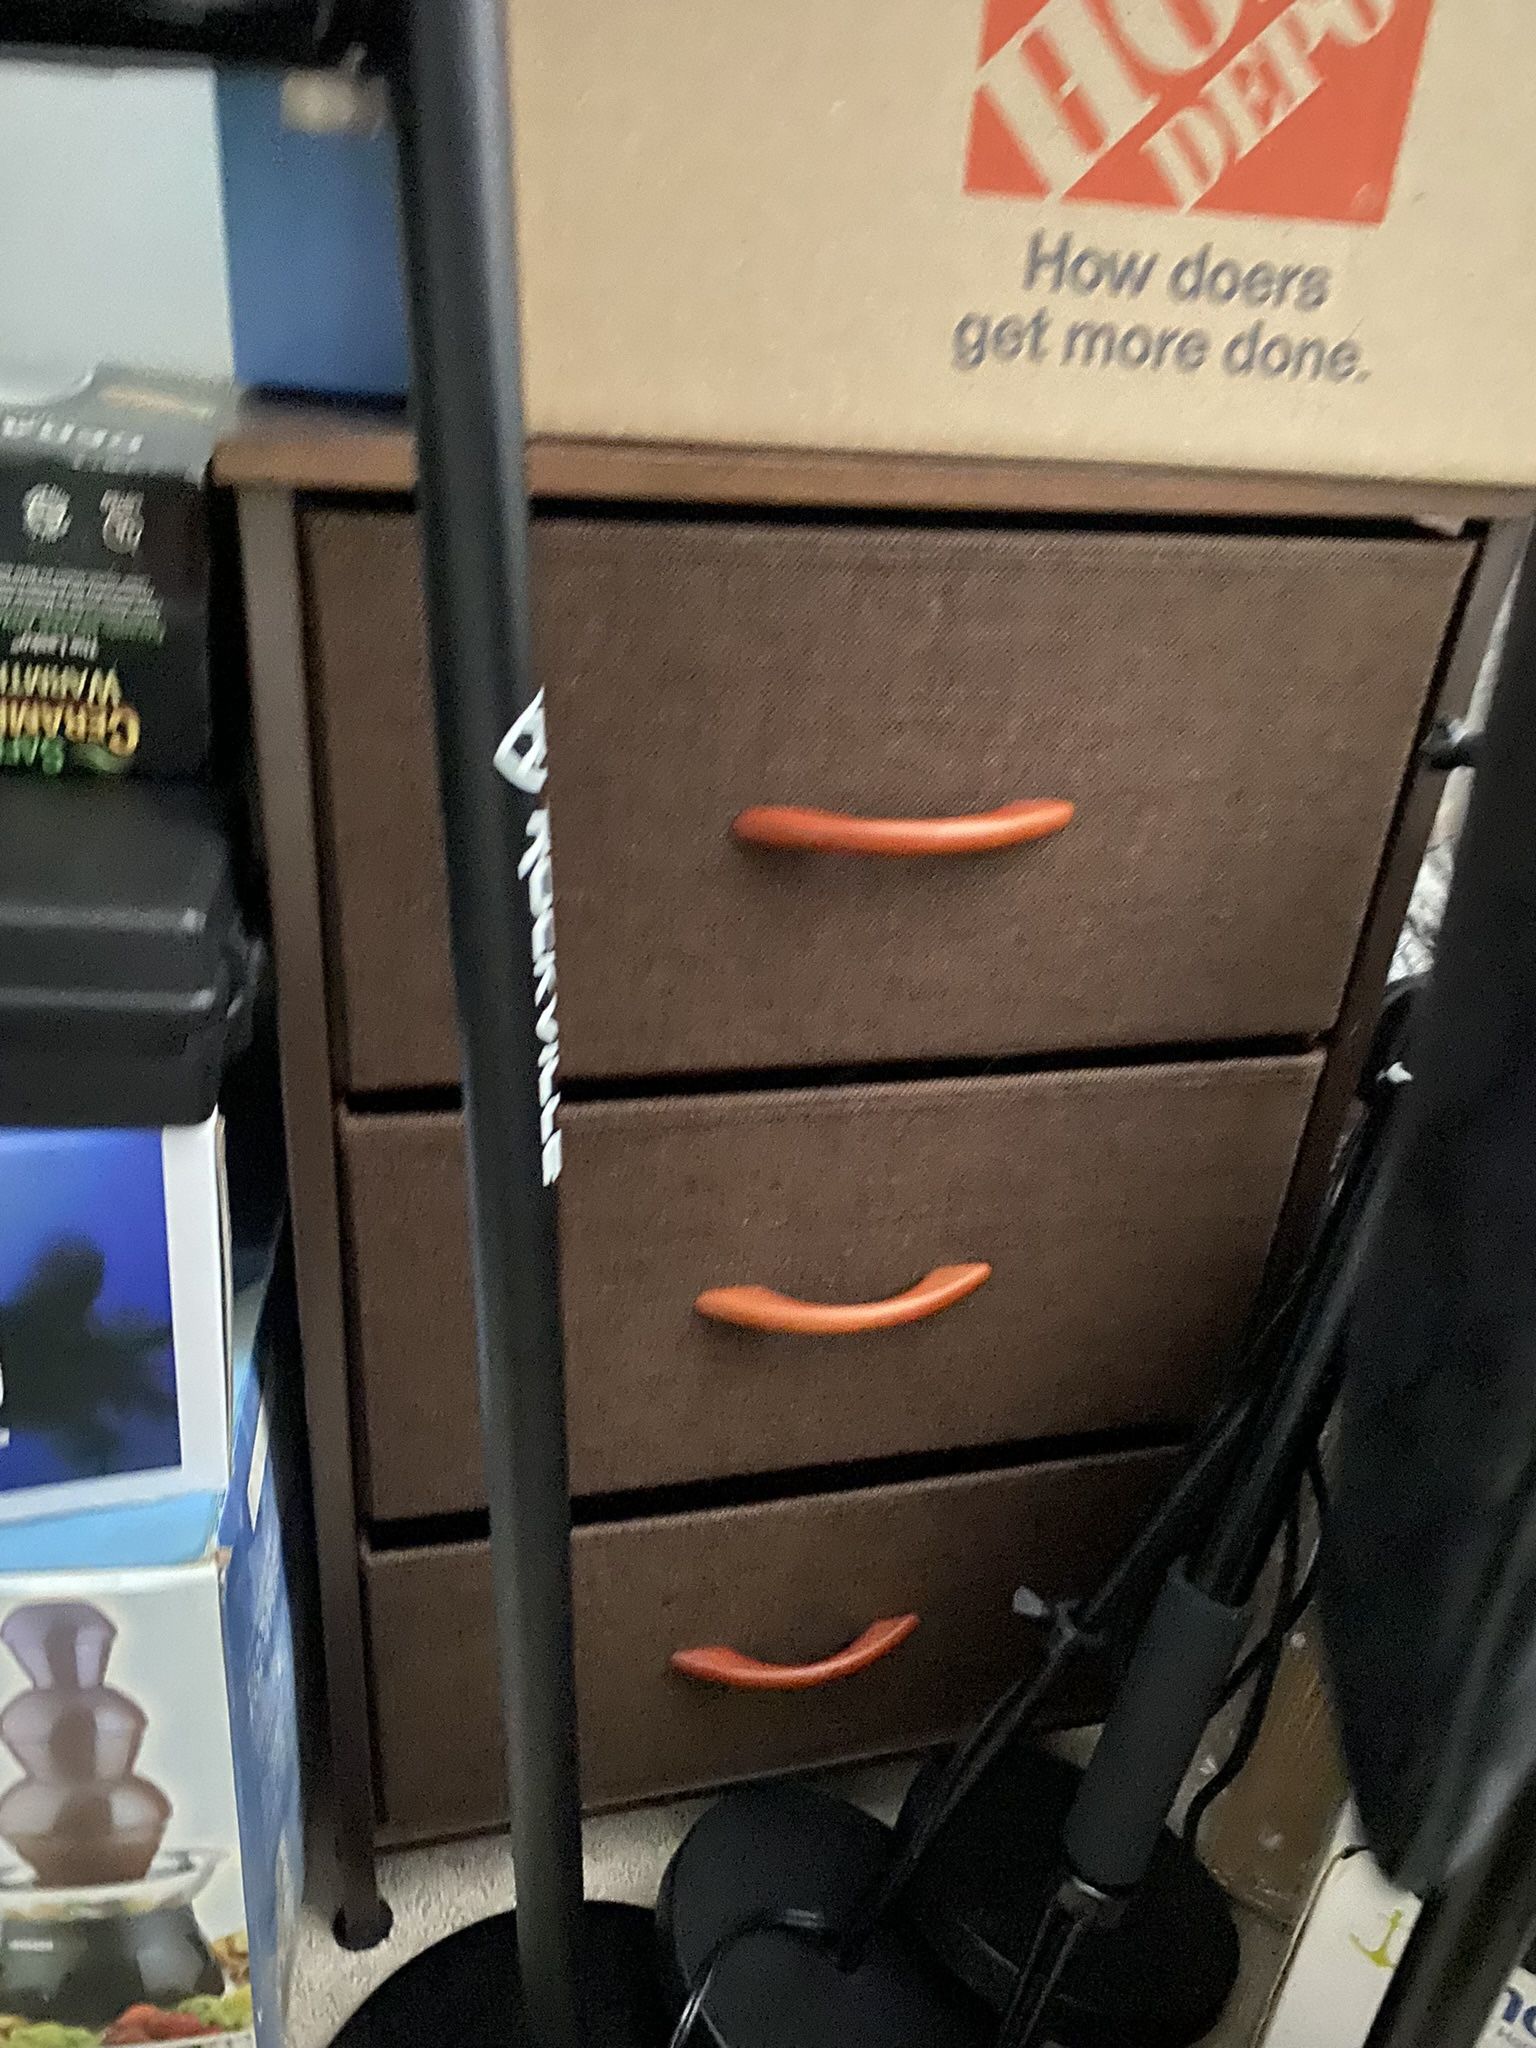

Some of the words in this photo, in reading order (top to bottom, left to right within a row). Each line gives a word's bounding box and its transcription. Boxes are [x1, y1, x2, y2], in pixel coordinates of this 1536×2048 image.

[1021, 227, 1160, 299] How
[1167, 241, 1333, 311] doers
[951, 305, 1053, 373] get
[1059, 318, 1211, 371] more
[1222, 317, 1372, 384] done.
